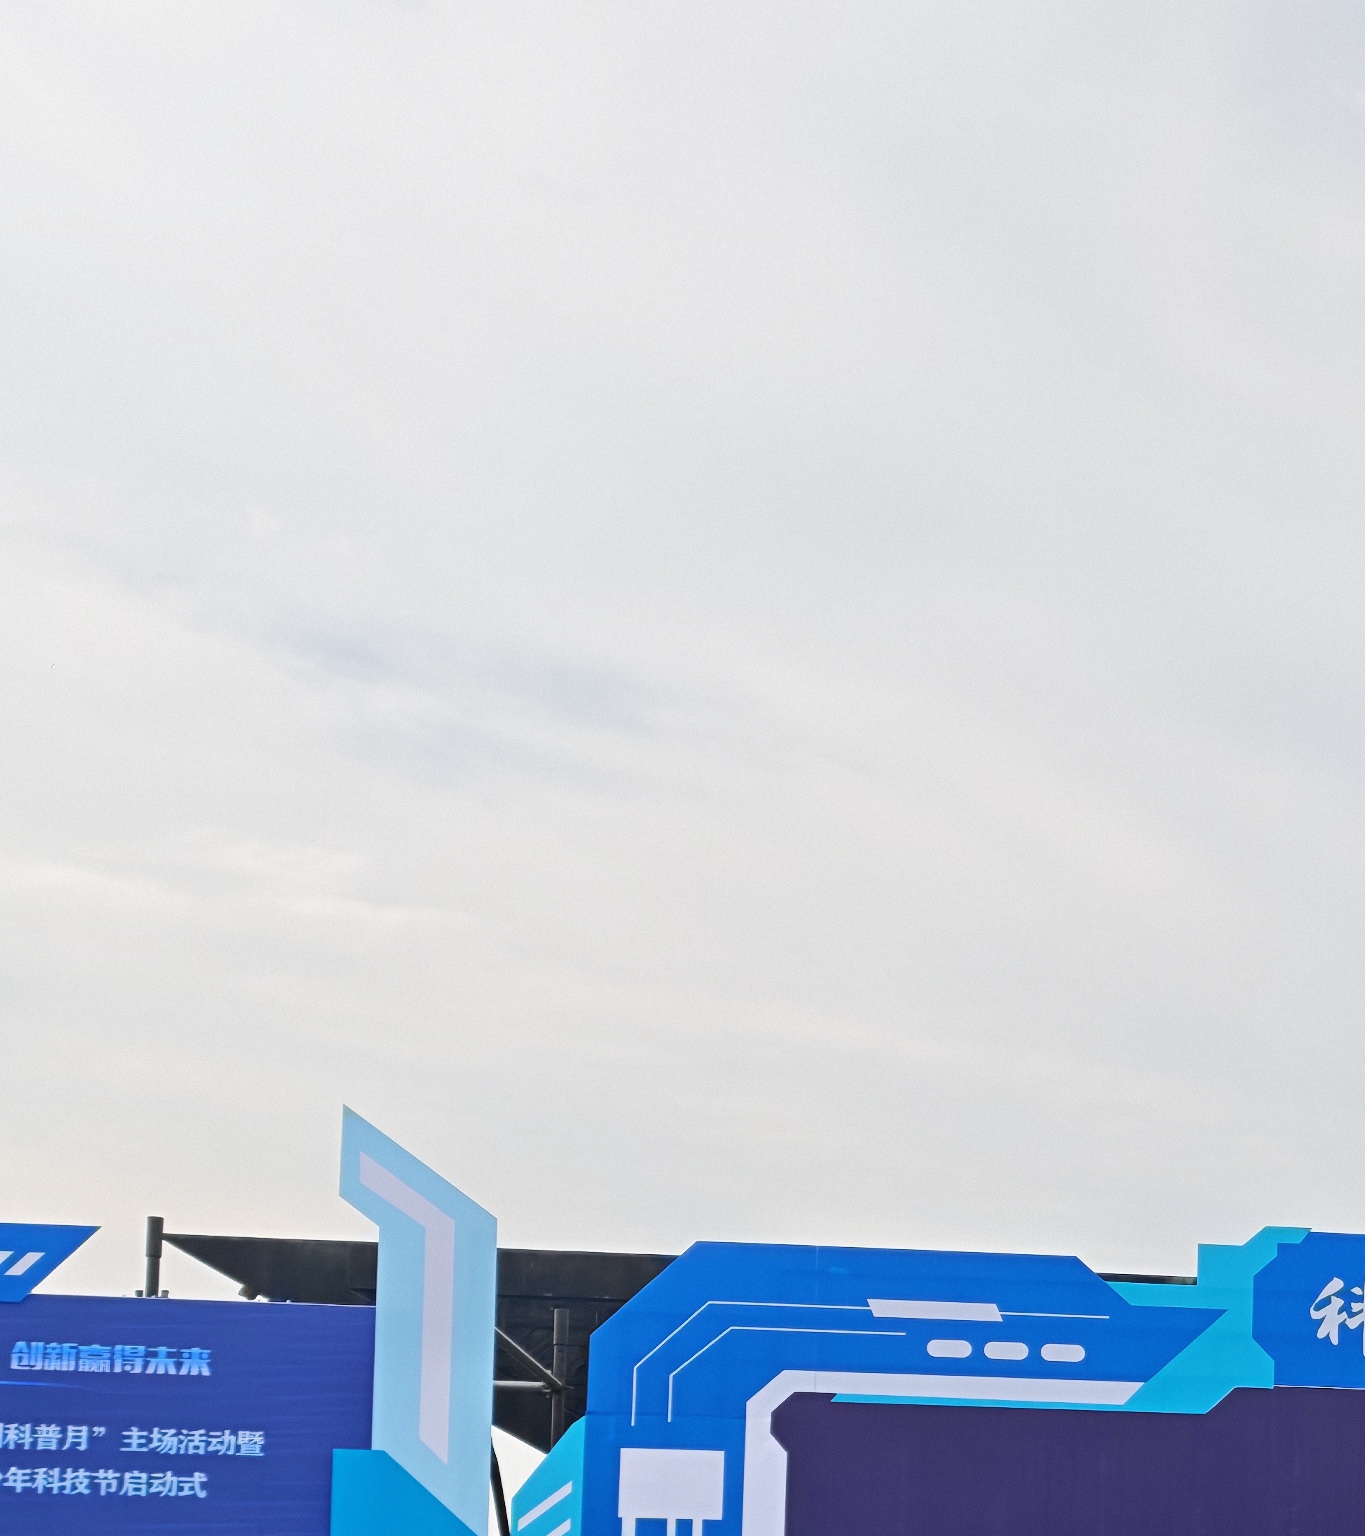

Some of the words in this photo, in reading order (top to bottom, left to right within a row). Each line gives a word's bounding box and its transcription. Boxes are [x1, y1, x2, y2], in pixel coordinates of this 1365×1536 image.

[10, 1341, 212, 1377] 创新赢得未来
